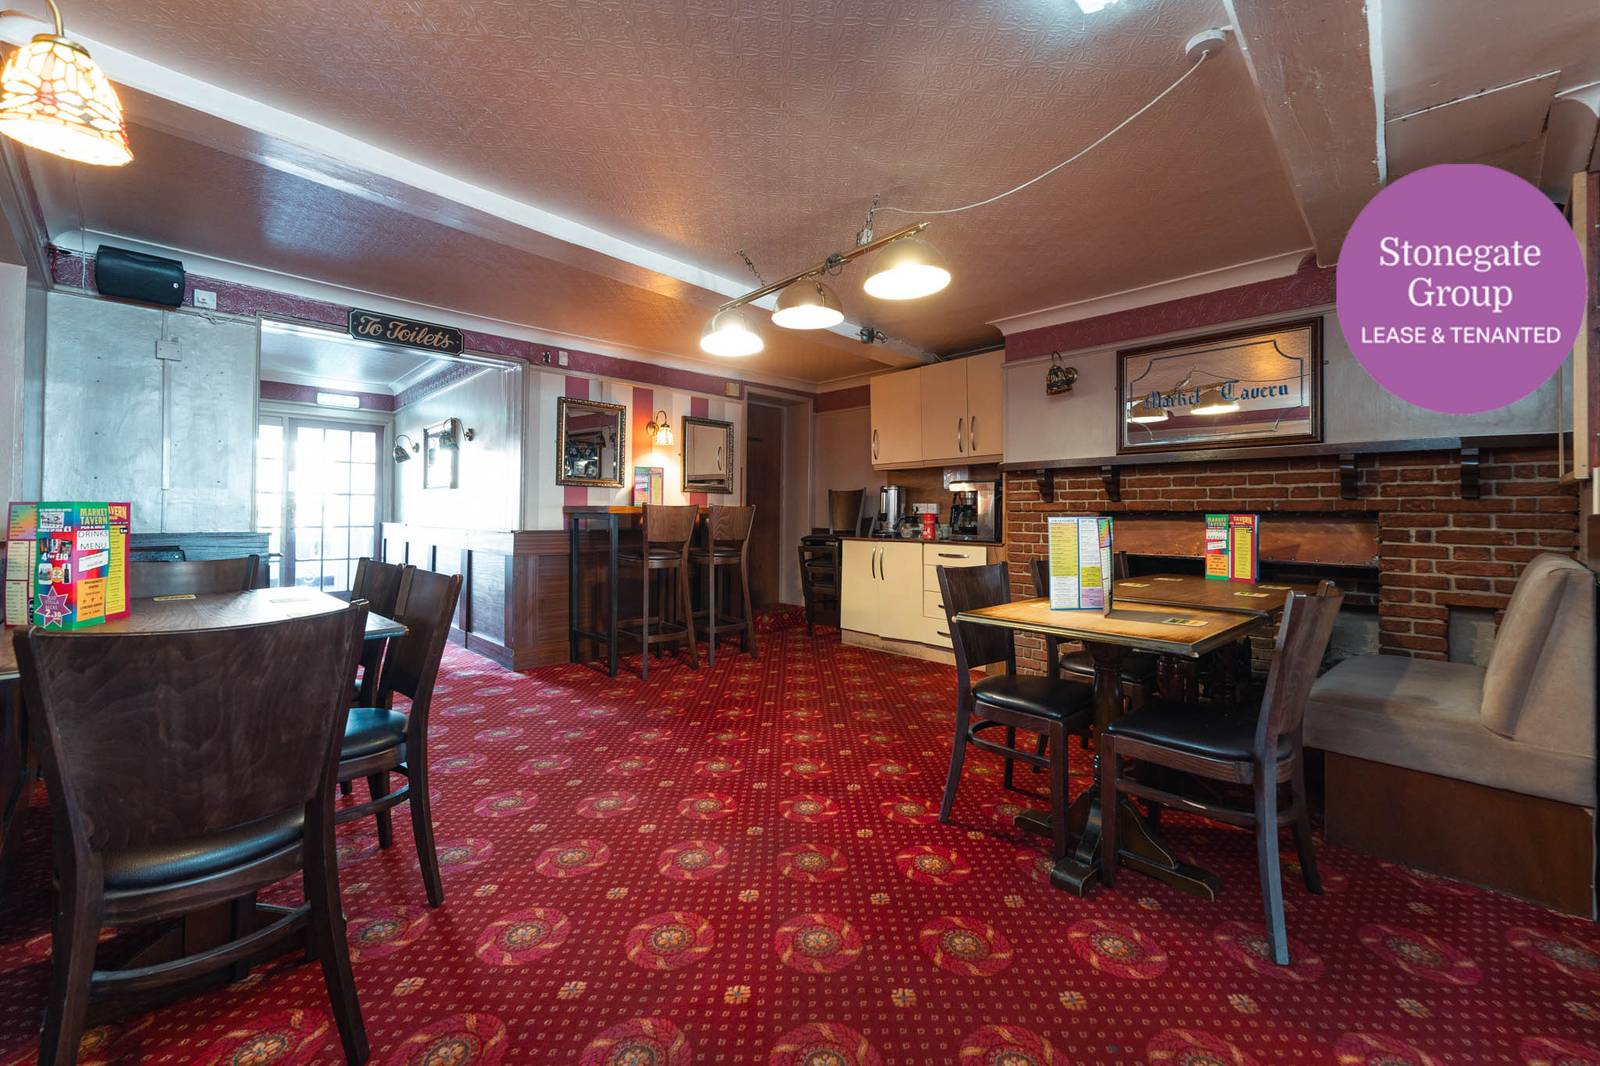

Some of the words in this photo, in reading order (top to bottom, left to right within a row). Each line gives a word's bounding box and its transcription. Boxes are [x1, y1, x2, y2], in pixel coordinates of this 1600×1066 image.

[358, 316, 383, 336] To
[386, 321, 454, 348] Toilets
[1220, 380, 1288, 401] Tavern
[80, 508, 107, 517] MARKET
[109, 505, 127, 520] AVERN
[80, 516, 107, 525] TAVERN
[80, 543, 107, 551] MENU
[42, 553, 47, 561] 4
